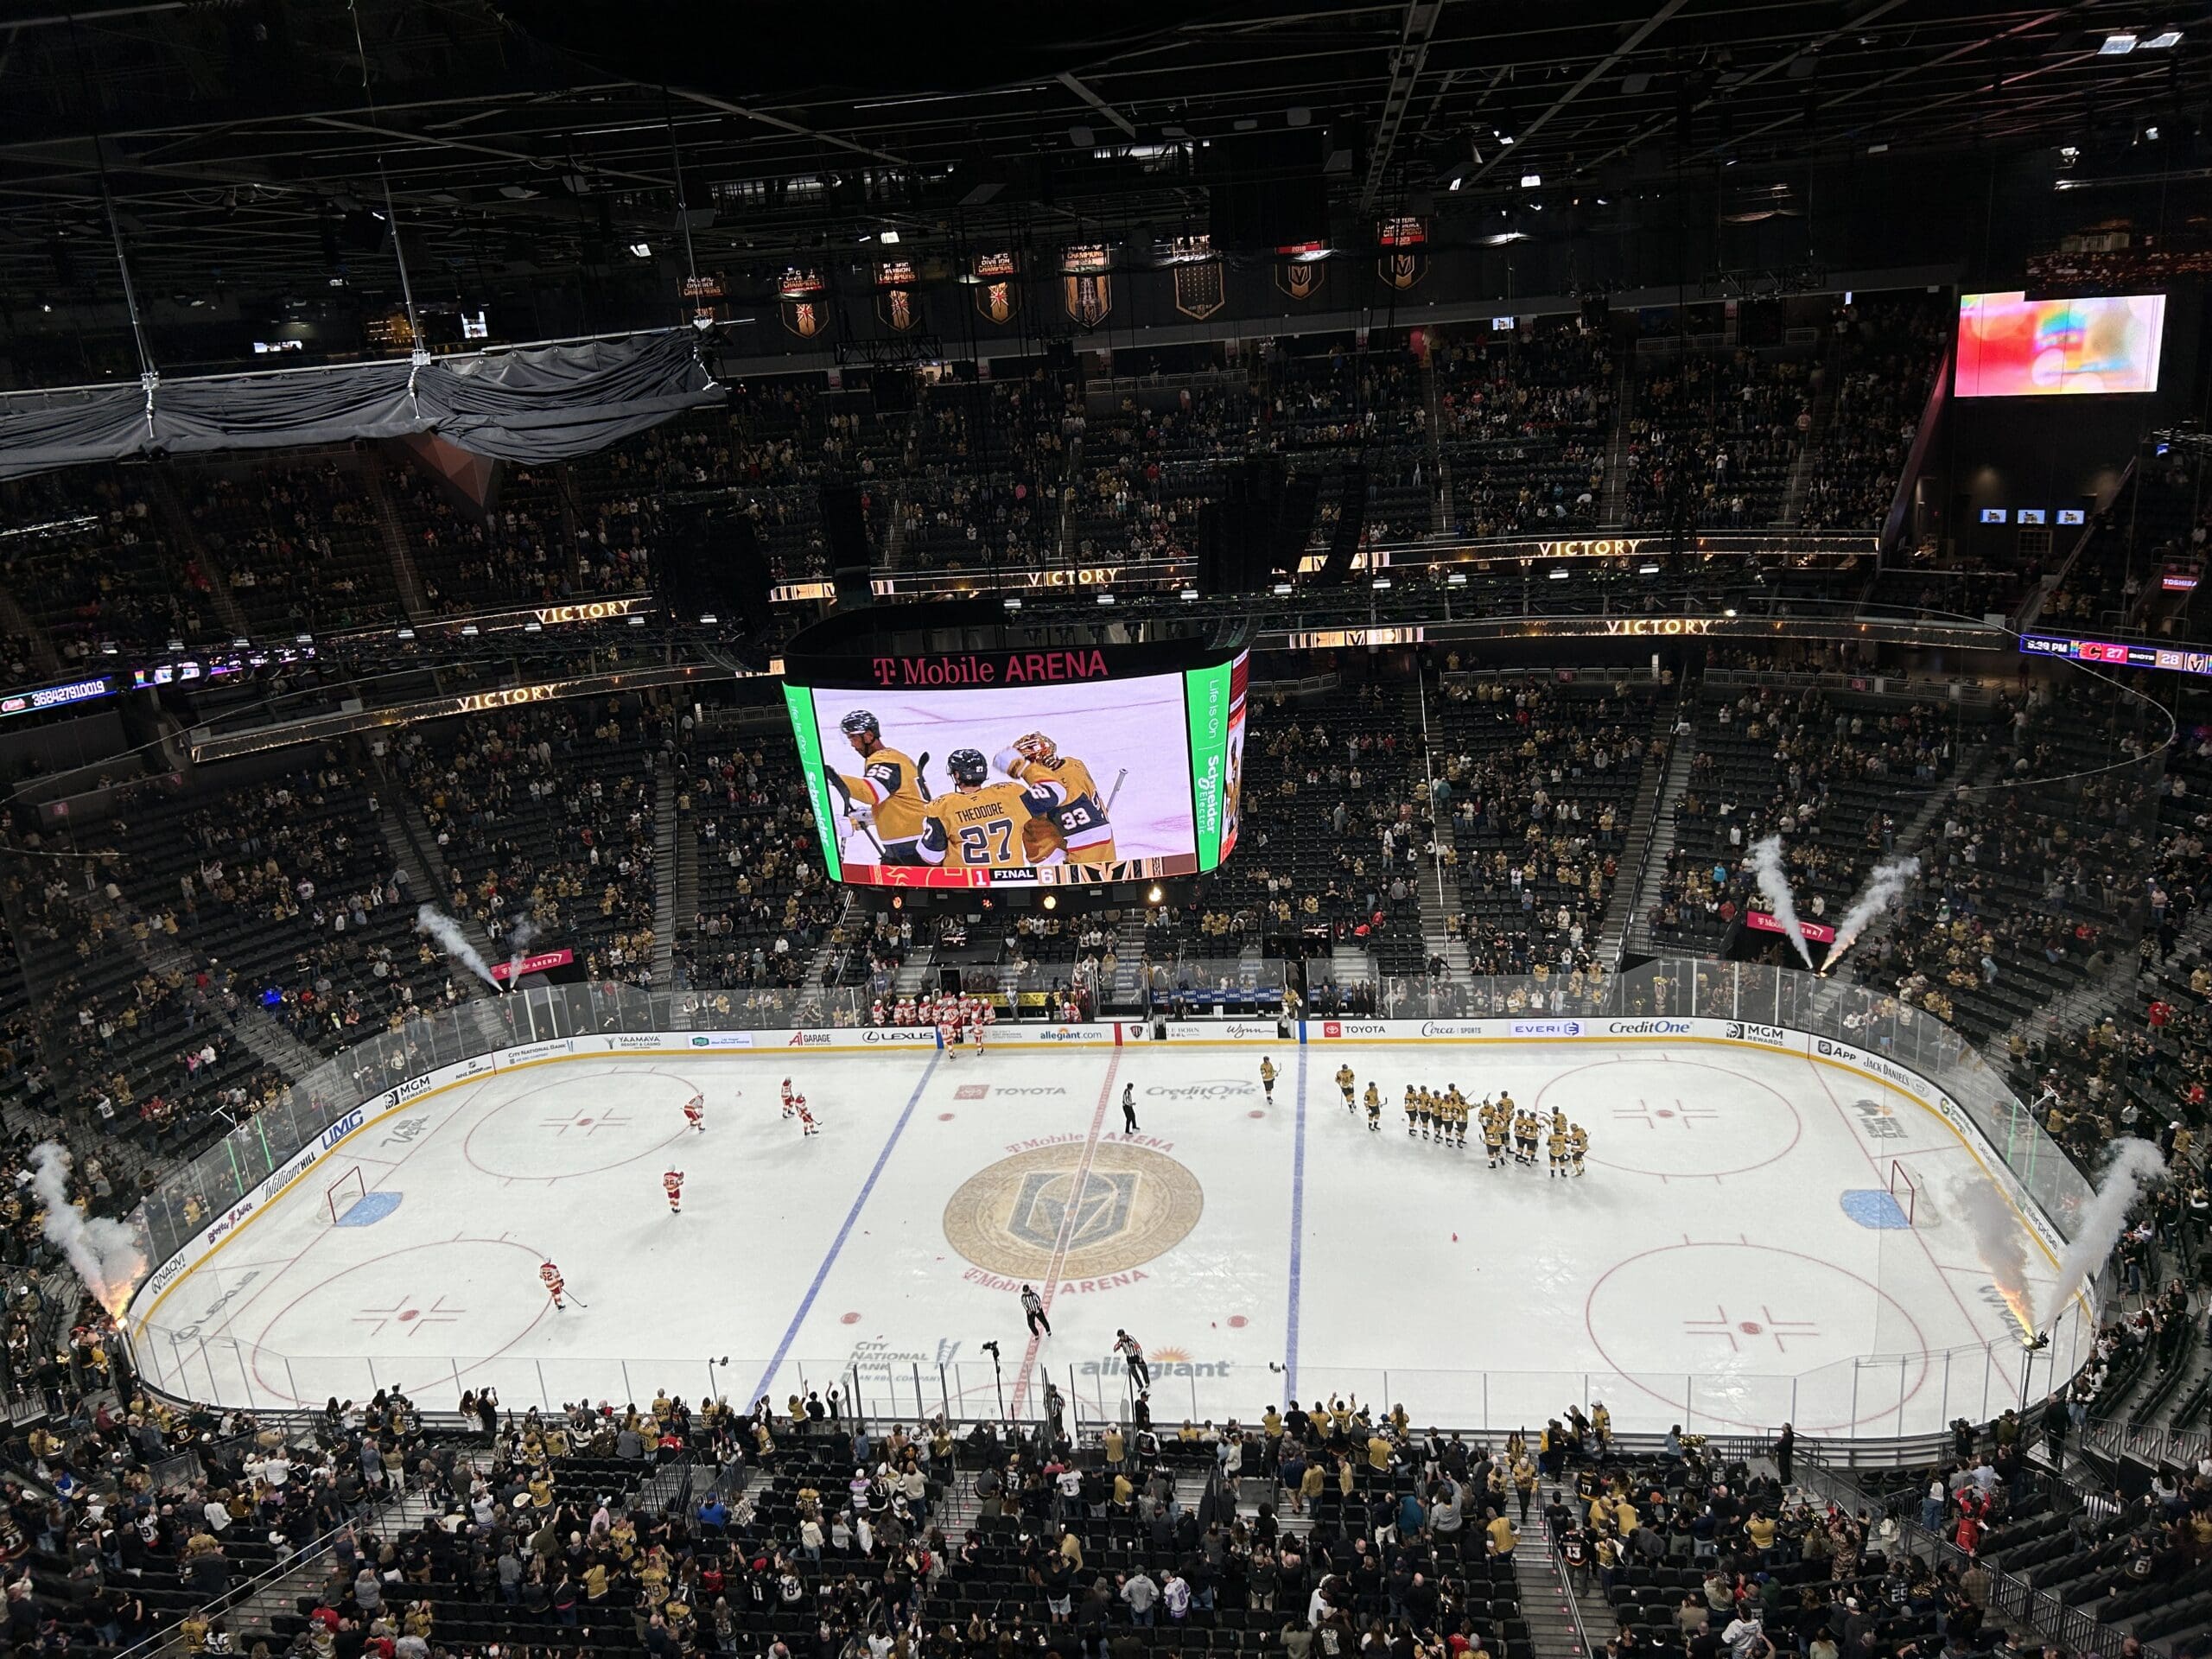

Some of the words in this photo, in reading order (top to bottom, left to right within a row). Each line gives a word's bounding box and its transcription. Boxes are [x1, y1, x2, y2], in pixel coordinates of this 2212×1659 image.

[1538, 538, 1641, 557] VICTORY
[1027, 568, 1118, 586] VICTORY
[534, 600, 631, 623] VICTORY
[1605, 619, 1711, 636] VICTORY
[2051, 642, 2068, 653] PM
[2106, 647, 2124, 659] 27
[1005, 649, 1109, 683] ARENA
[2160, 652, 2179, 666] 28
[456, 684, 556, 711] VICTORY
[1209, 679, 1220, 704] Life
[1207, 754, 1220, 834] Schneider
[955, 802, 1005, 823] THEODORE
[1061, 807, 1091, 830] 33
[1198, 791, 1206, 835] Electric
[959, 817, 1014, 865] 27
[976, 870, 987, 886] 1
[994, 869, 1034, 880] FINAL
[1040, 868, 1054, 885] 6
[1801, 926, 1818, 936] ENA
[532, 957, 558, 969] ARENA
[880, 1032, 935, 1041] LEXUS
[1040, 1030, 1103, 1041] allegiant.com
[1344, 1025, 1386, 1034] TOYOTA
[1421, 1020, 1455, 1038] Circa
[1460, 1027, 1482, 1035] SPORTS
[1515, 1025, 1560, 1033] EVERI
[1747, 1024, 1783, 1039] MGM
[804, 1033, 831, 1043] GARAGE
[1747, 1035, 1783, 1046] REWARDS
[520, 1046, 550, 1056] NATIONAL
[1863, 1057, 1882, 1072] JACK
[400, 1075, 431, 1096] MGM
[995, 1087, 1066, 1096] TOYOTA
[402, 1086, 433, 1103] REWARDS
[321, 1109, 365, 1151] UMC
[1103, 1131, 1175, 1153] ARENA
[262, 1160, 301, 1203] William
[300, 1151, 317, 1171] HILL
[2025, 1206, 2059, 1251] terprise
[159, 1252, 186, 1281] NAQVI
[1059, 1269, 1150, 1296] ARENA
[855, 1341, 890, 1351] CITY
[849, 1351, 931, 1361] NATIONAL
[176, 1429, 189, 1440] 81
[1566, 1546, 1581, 1560] 13
